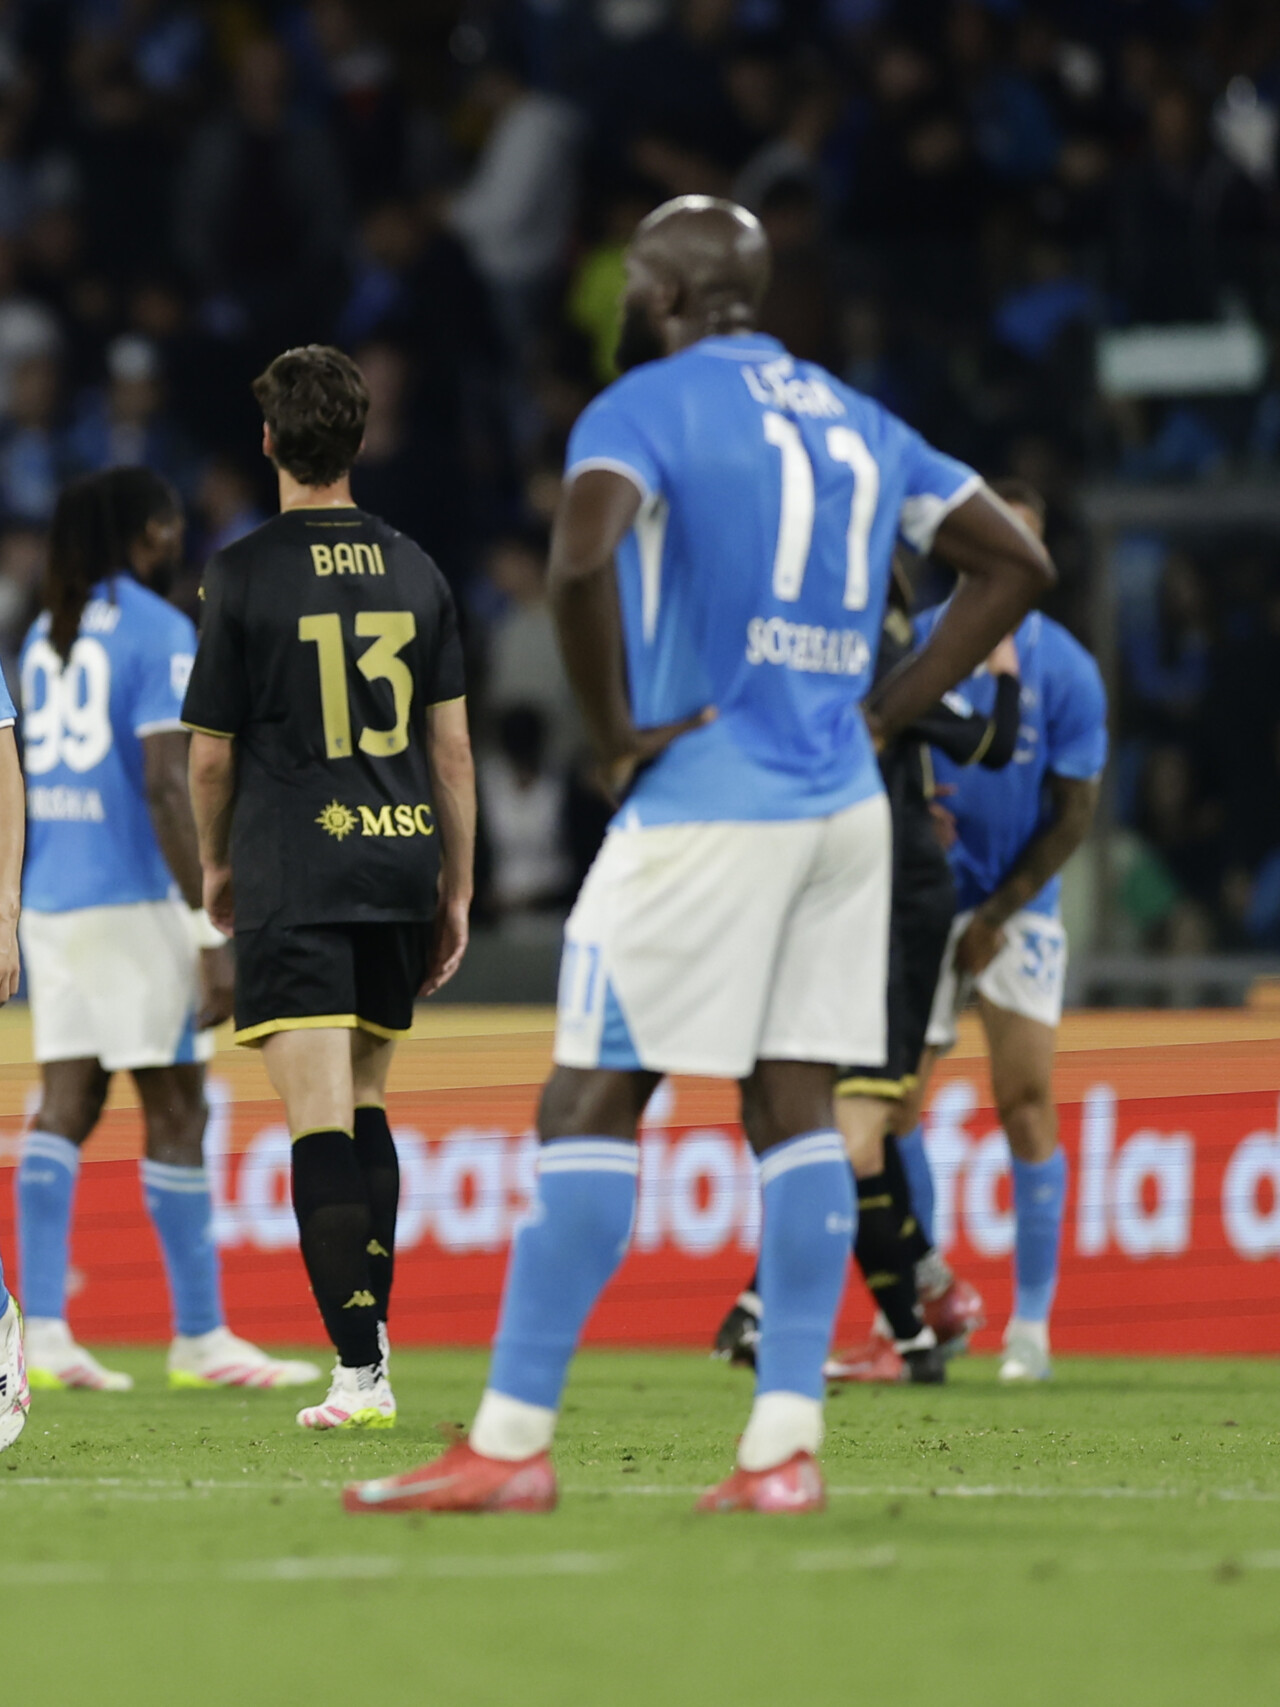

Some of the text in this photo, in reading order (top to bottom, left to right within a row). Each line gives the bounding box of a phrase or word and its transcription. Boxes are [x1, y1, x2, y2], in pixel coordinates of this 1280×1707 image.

[310, 542, 385, 576] BANI
[762, 411, 878, 610] 11
[21, 636, 113, 774] 99
[298, 611, 417, 760] 13
[356, 804, 434, 837] MSC
[1077, 1082, 1195, 1260] la
